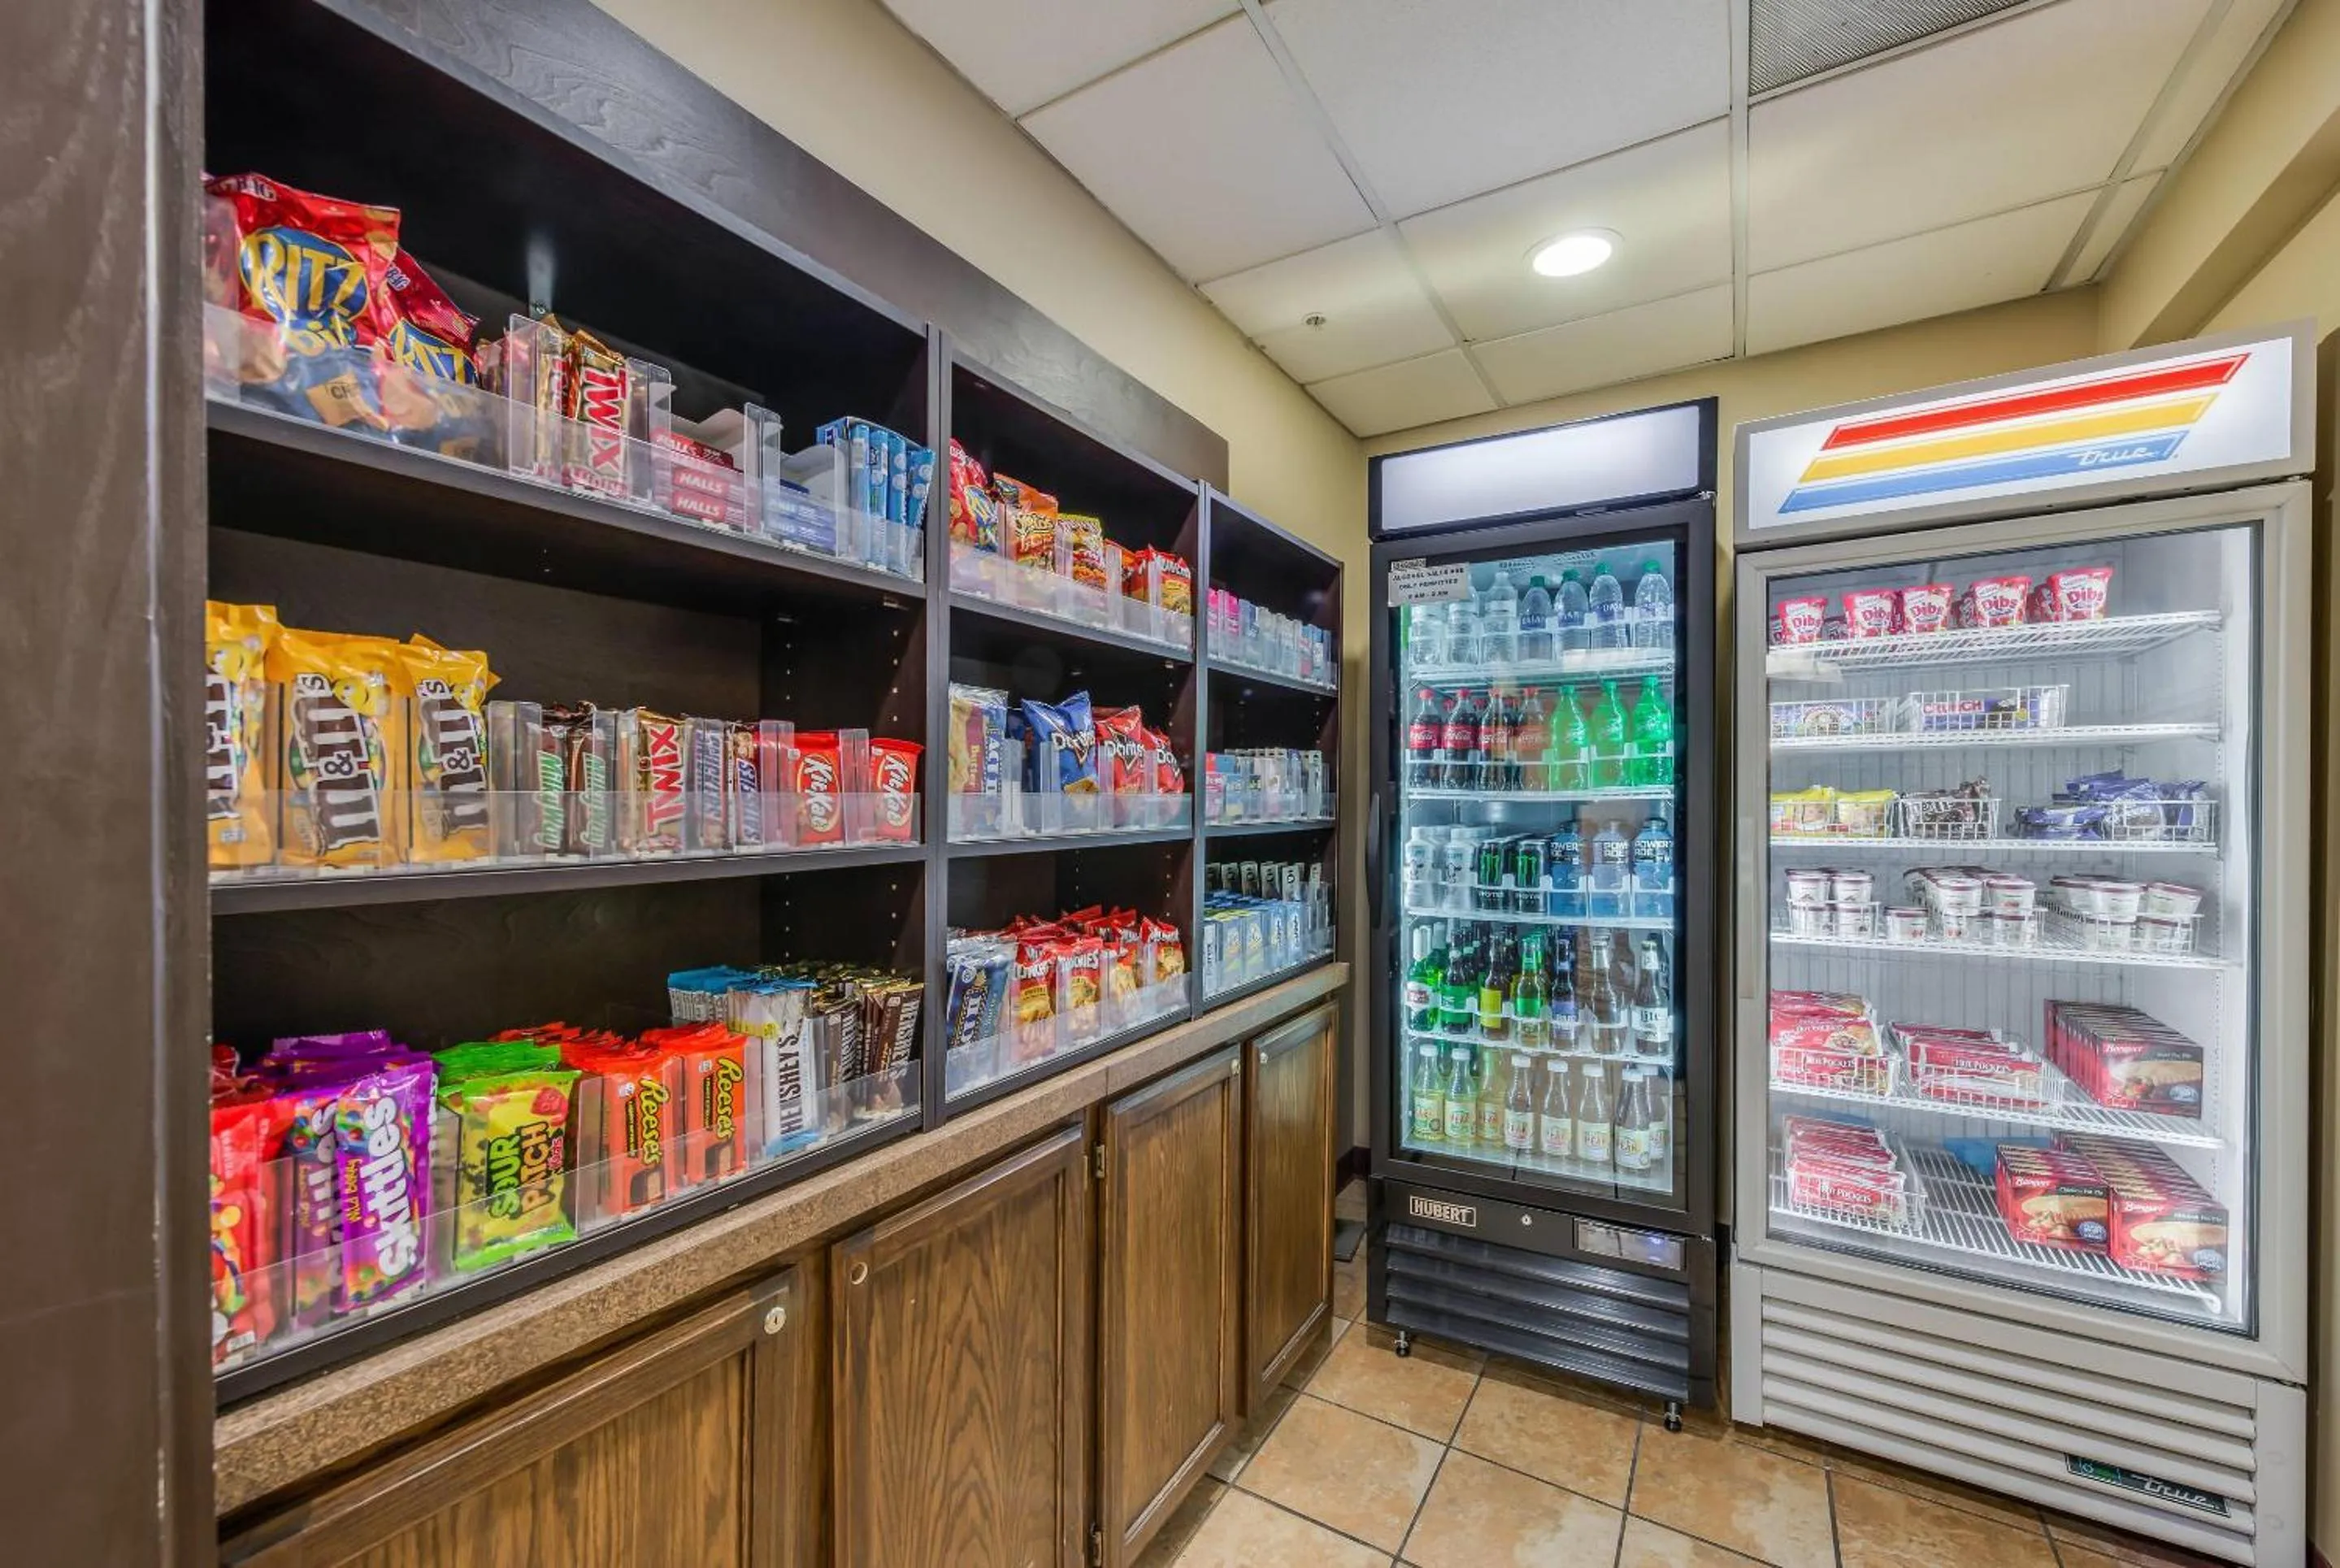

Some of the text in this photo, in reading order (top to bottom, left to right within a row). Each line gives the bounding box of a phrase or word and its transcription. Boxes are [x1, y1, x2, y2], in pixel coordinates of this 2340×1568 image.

[242, 232, 367, 325] RITZ
[584, 367, 630, 475] TWIX
[2067, 446, 2155, 467] True
[679, 472, 723, 493] HALLS
[676, 497, 720, 517] HALLS
[1792, 614, 1821, 628] Dibs
[1981, 595, 2018, 610] Dibs
[646, 723, 687, 834] TWIX
[967, 745, 980, 788] Butter
[717, 1056, 745, 1140] Reese's
[638, 1076, 671, 1165] Reese's
[360, 1096, 419, 1276] Skittles
[487, 1133, 522, 1219] SOUR
[517, 1120, 557, 1215] PATCH
[1413, 1199, 1470, 1224] HUBERT
[1837, 1188, 1872, 1203] POCKETS
[2130, 1472, 2216, 1509] True
